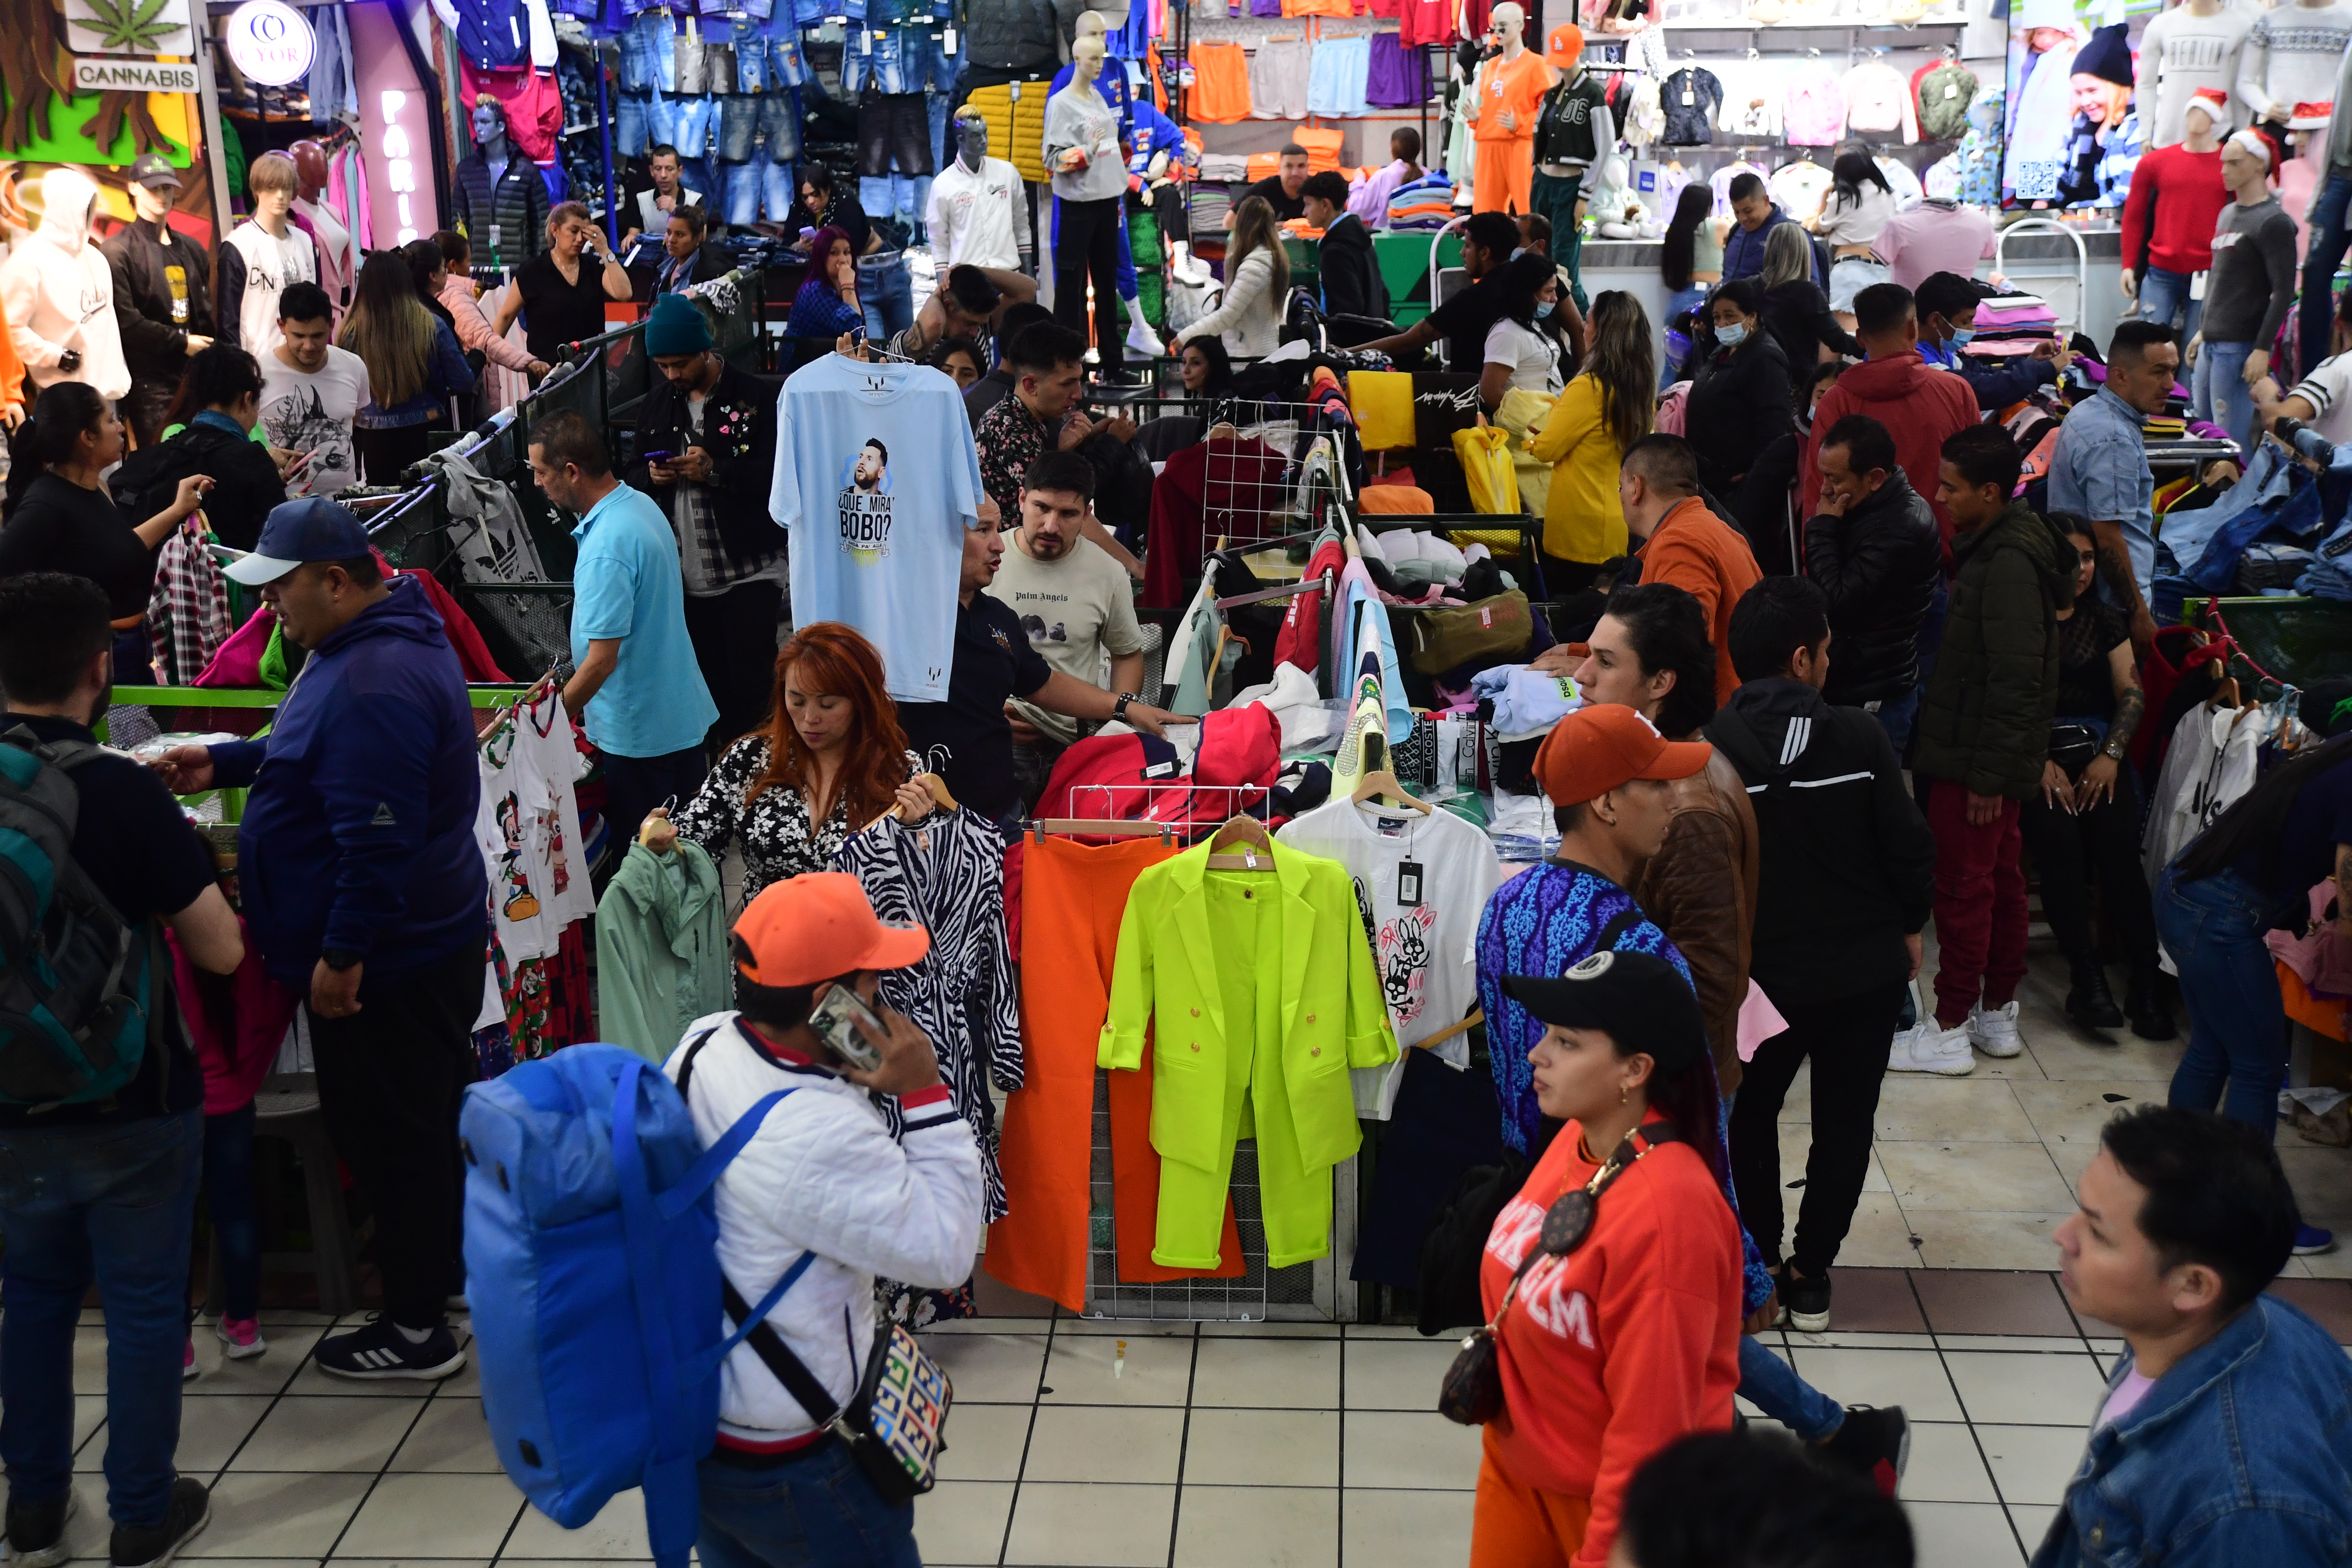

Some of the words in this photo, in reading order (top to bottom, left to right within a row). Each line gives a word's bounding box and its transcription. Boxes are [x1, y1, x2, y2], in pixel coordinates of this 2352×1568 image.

[79, 66, 194, 87] CANNABIS
[1560, 98, 1590, 125] 06
[838, 493, 863, 512] ¿QUE
[840, 509, 891, 541] BOBO?
[1015, 591, 1037, 602] Palm
[1039, 592, 1068, 603] Angels
[1424, 720, 1433, 769] LACOSTE
[1462, 721, 1475, 758] Calvin
